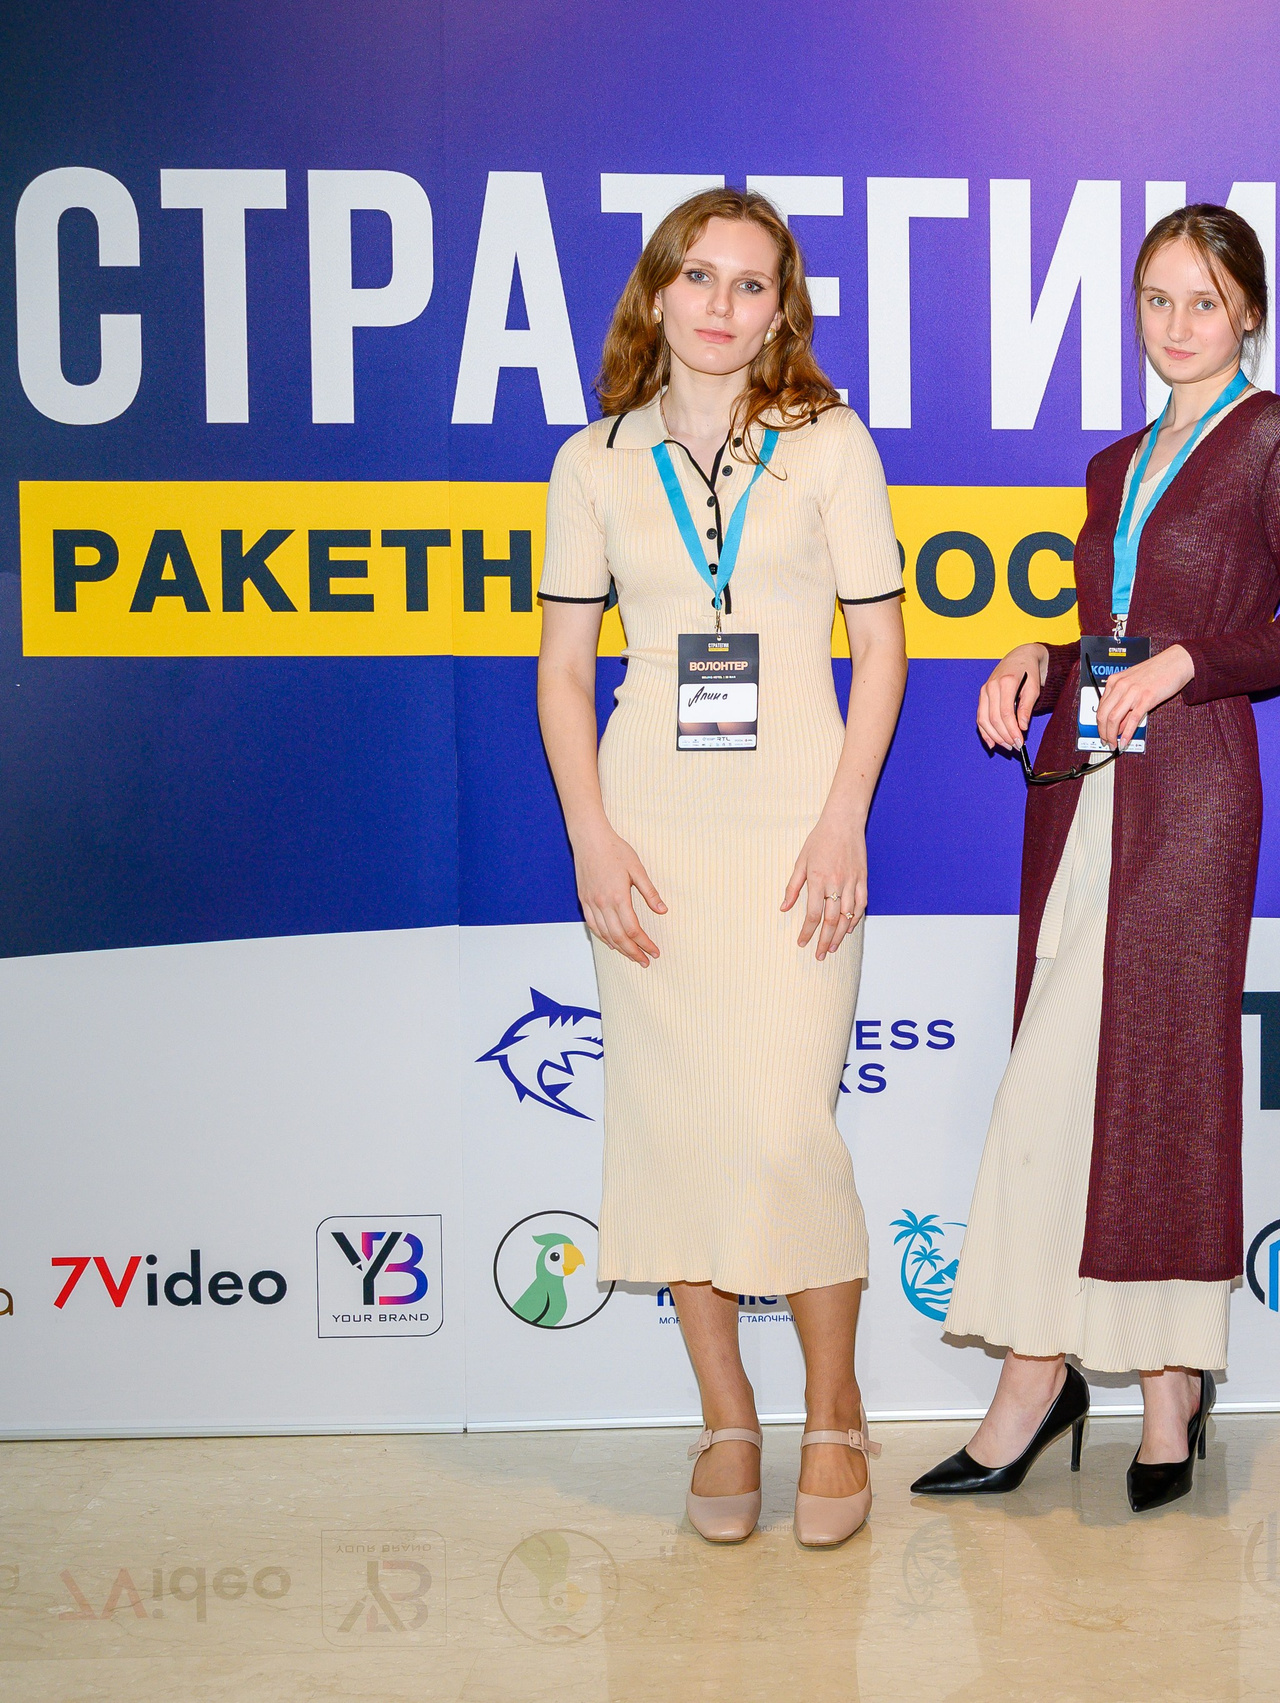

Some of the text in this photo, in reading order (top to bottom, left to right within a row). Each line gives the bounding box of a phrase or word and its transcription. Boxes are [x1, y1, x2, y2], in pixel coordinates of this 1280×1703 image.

[53, 529, 618, 614] РАКЕТН
[689, 661, 748, 671] ВОЛОНТЕР
[1091, 666, 1131, 675] КОМАН
[52, 1250, 288, 1310] 7Video
[332, 1313, 429, 1322] YOUR BRAND
